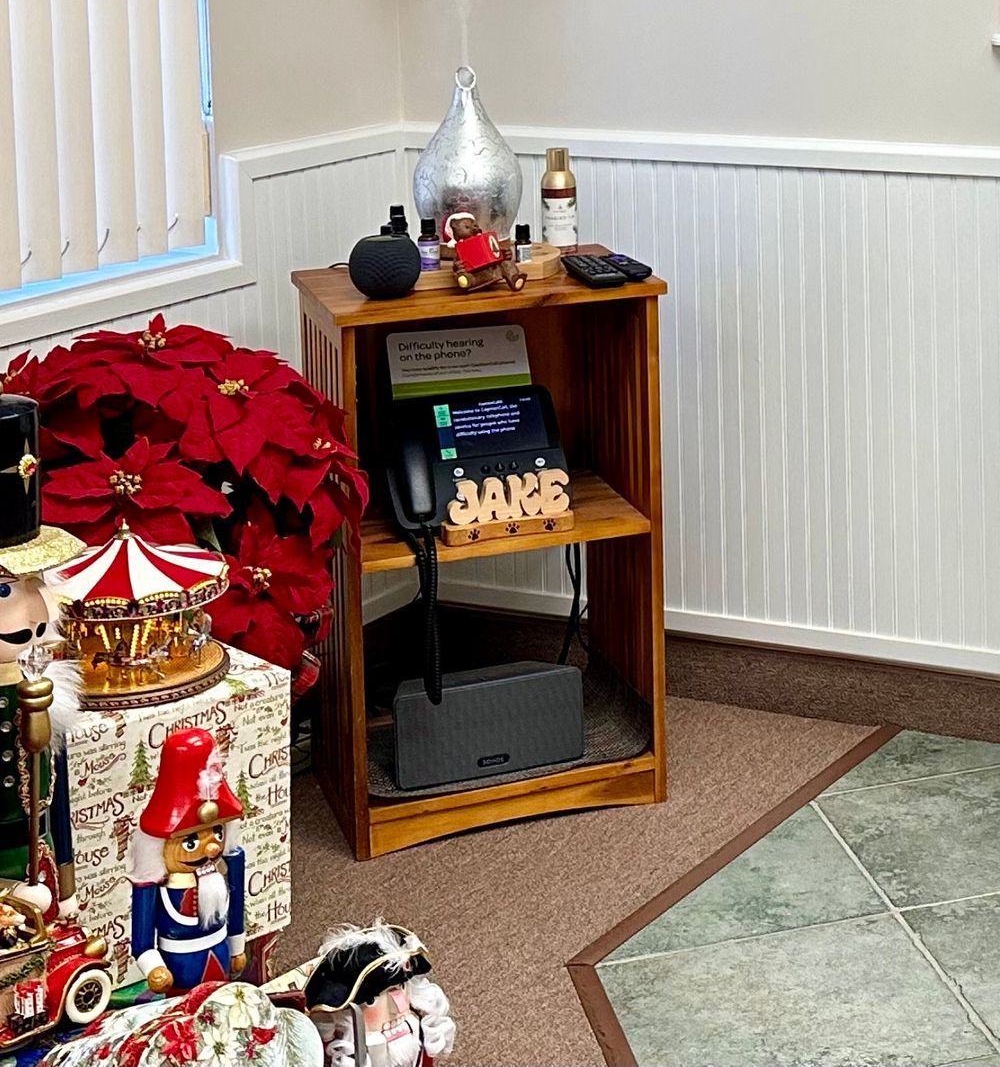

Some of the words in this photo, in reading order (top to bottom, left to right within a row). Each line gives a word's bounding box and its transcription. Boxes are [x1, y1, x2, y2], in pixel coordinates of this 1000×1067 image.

[398, 339, 445, 352] Difficulty
[446, 337, 485, 348] hearing
[399, 353, 413, 362] on
[415, 351, 432, 361] the
[434, 348, 472, 362] phone?
[447, 468, 570, 525] JAKE
